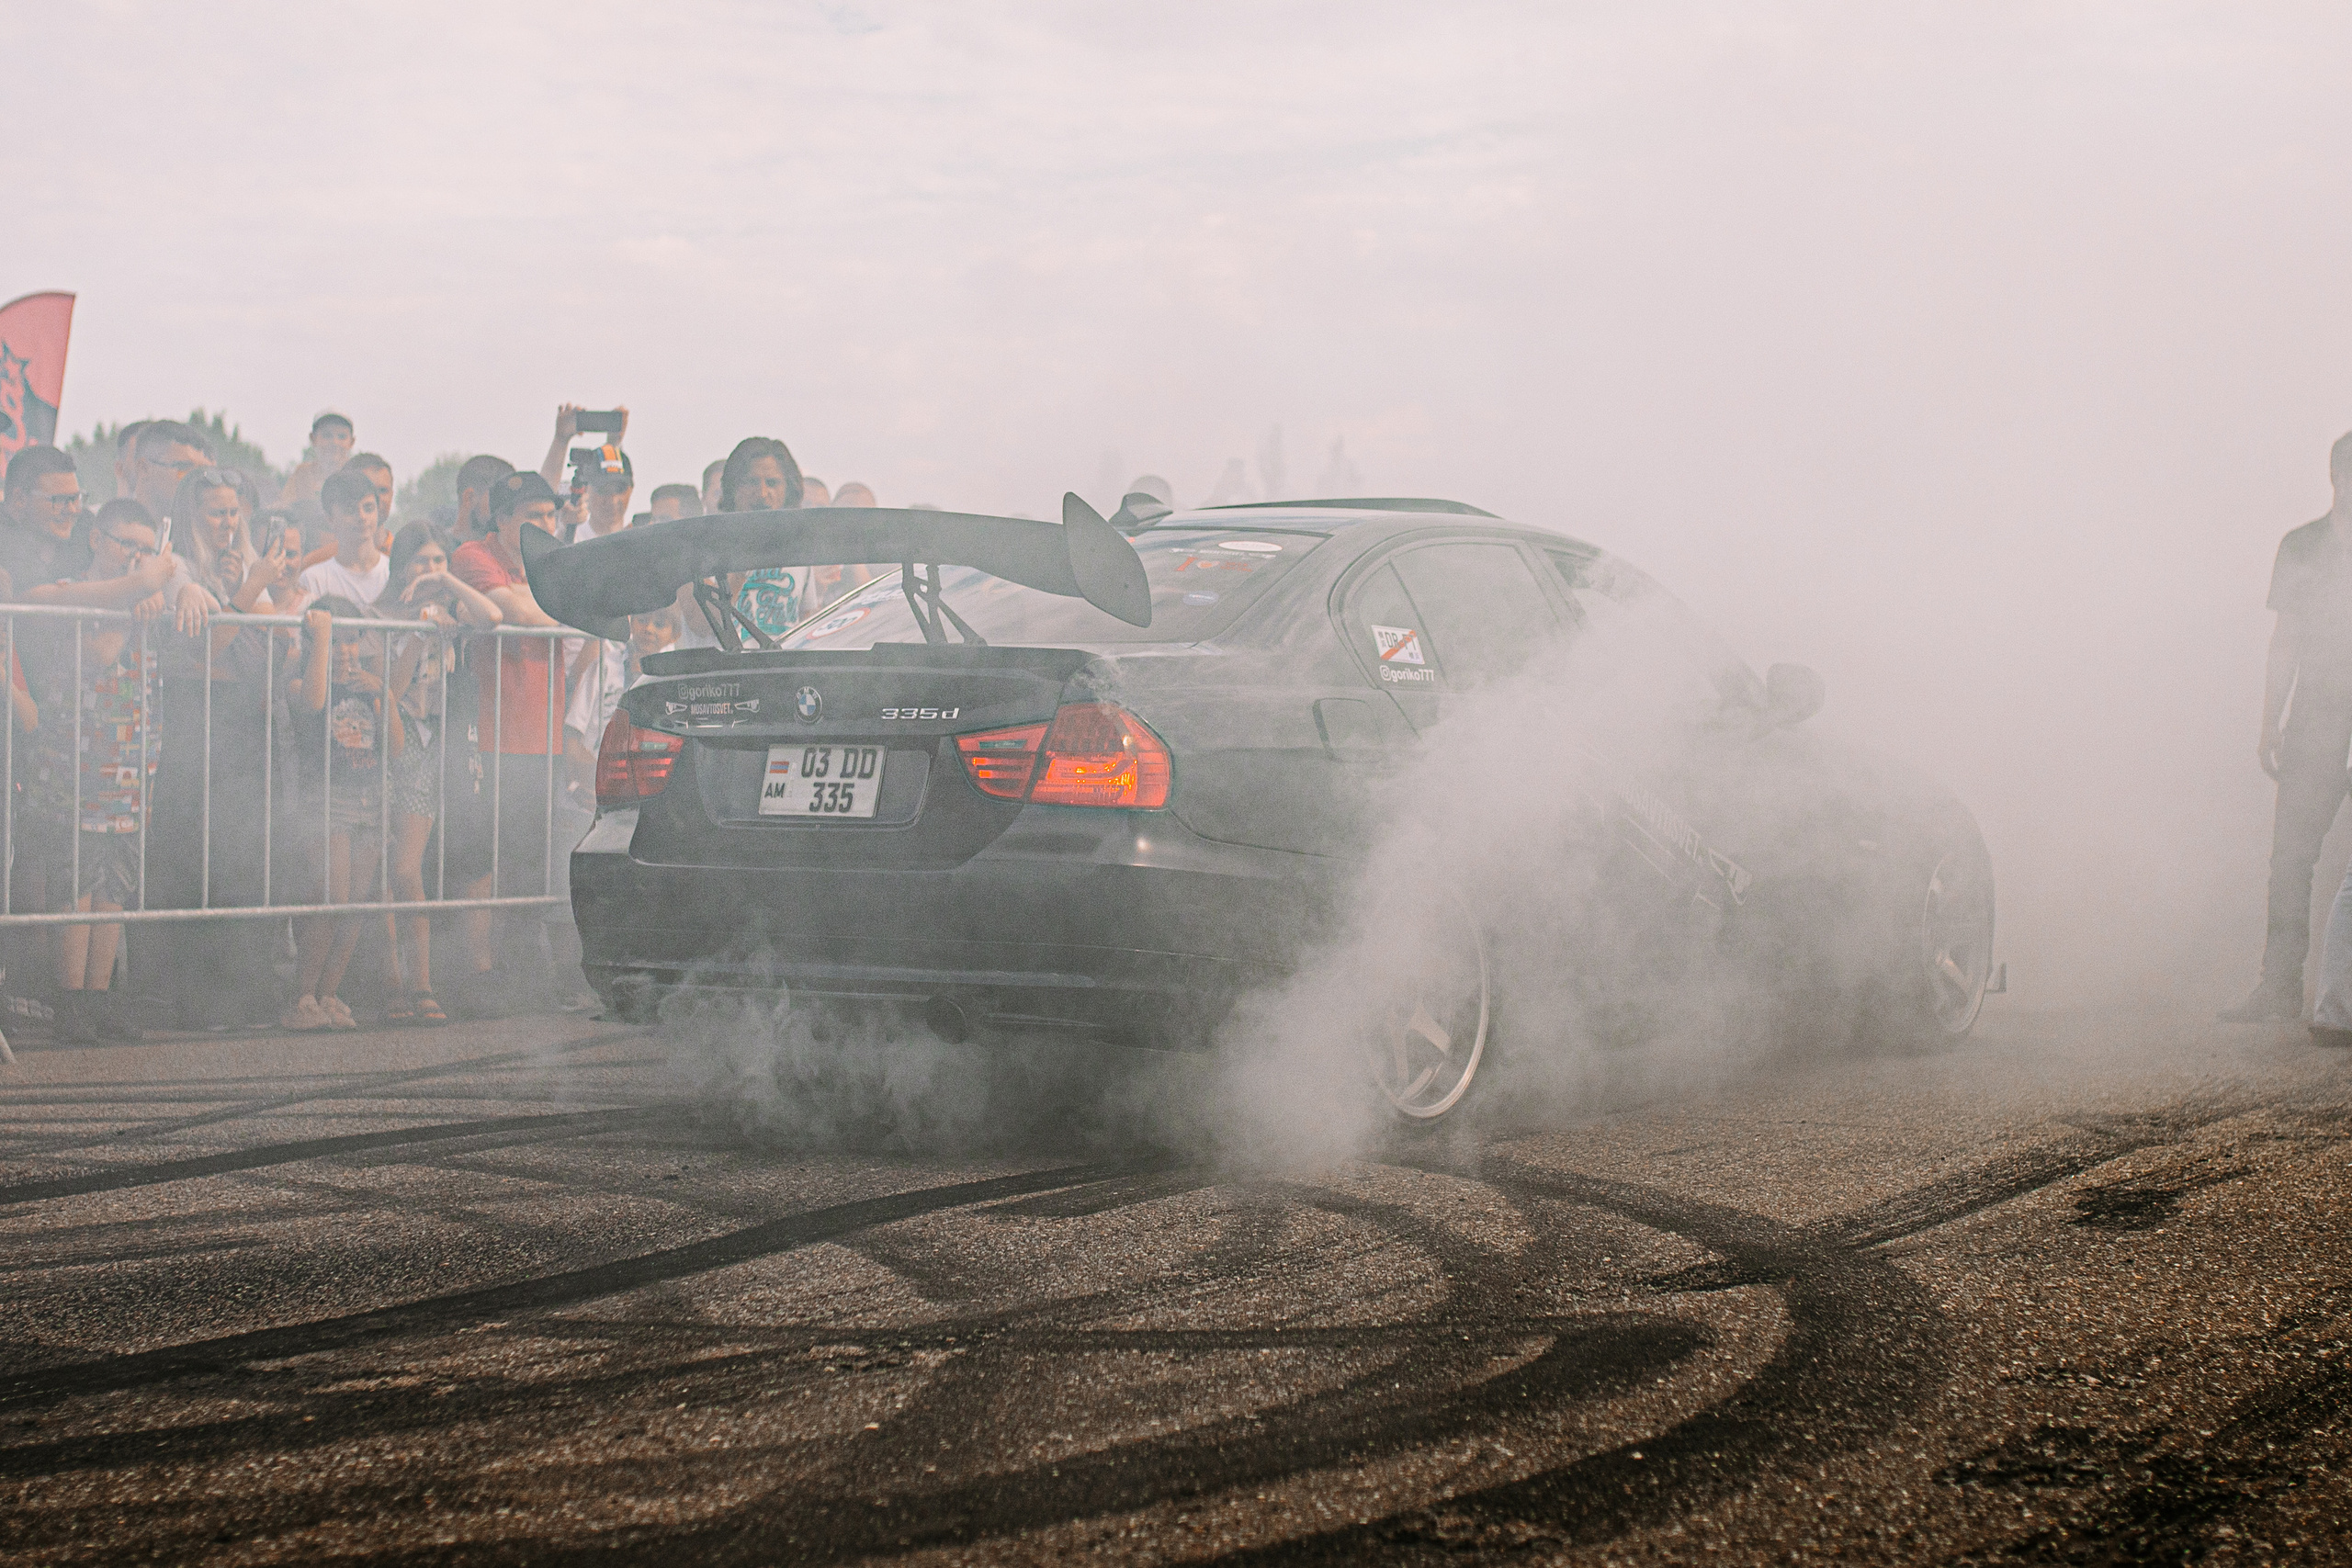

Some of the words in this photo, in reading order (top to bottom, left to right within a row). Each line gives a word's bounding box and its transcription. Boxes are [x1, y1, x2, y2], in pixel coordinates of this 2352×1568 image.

[881, 707, 960, 720] 335d
[800, 747, 831, 778] 03
[840, 748, 877, 779] DD
[763, 783, 786, 798] AM
[808, 782, 855, 813] 335
